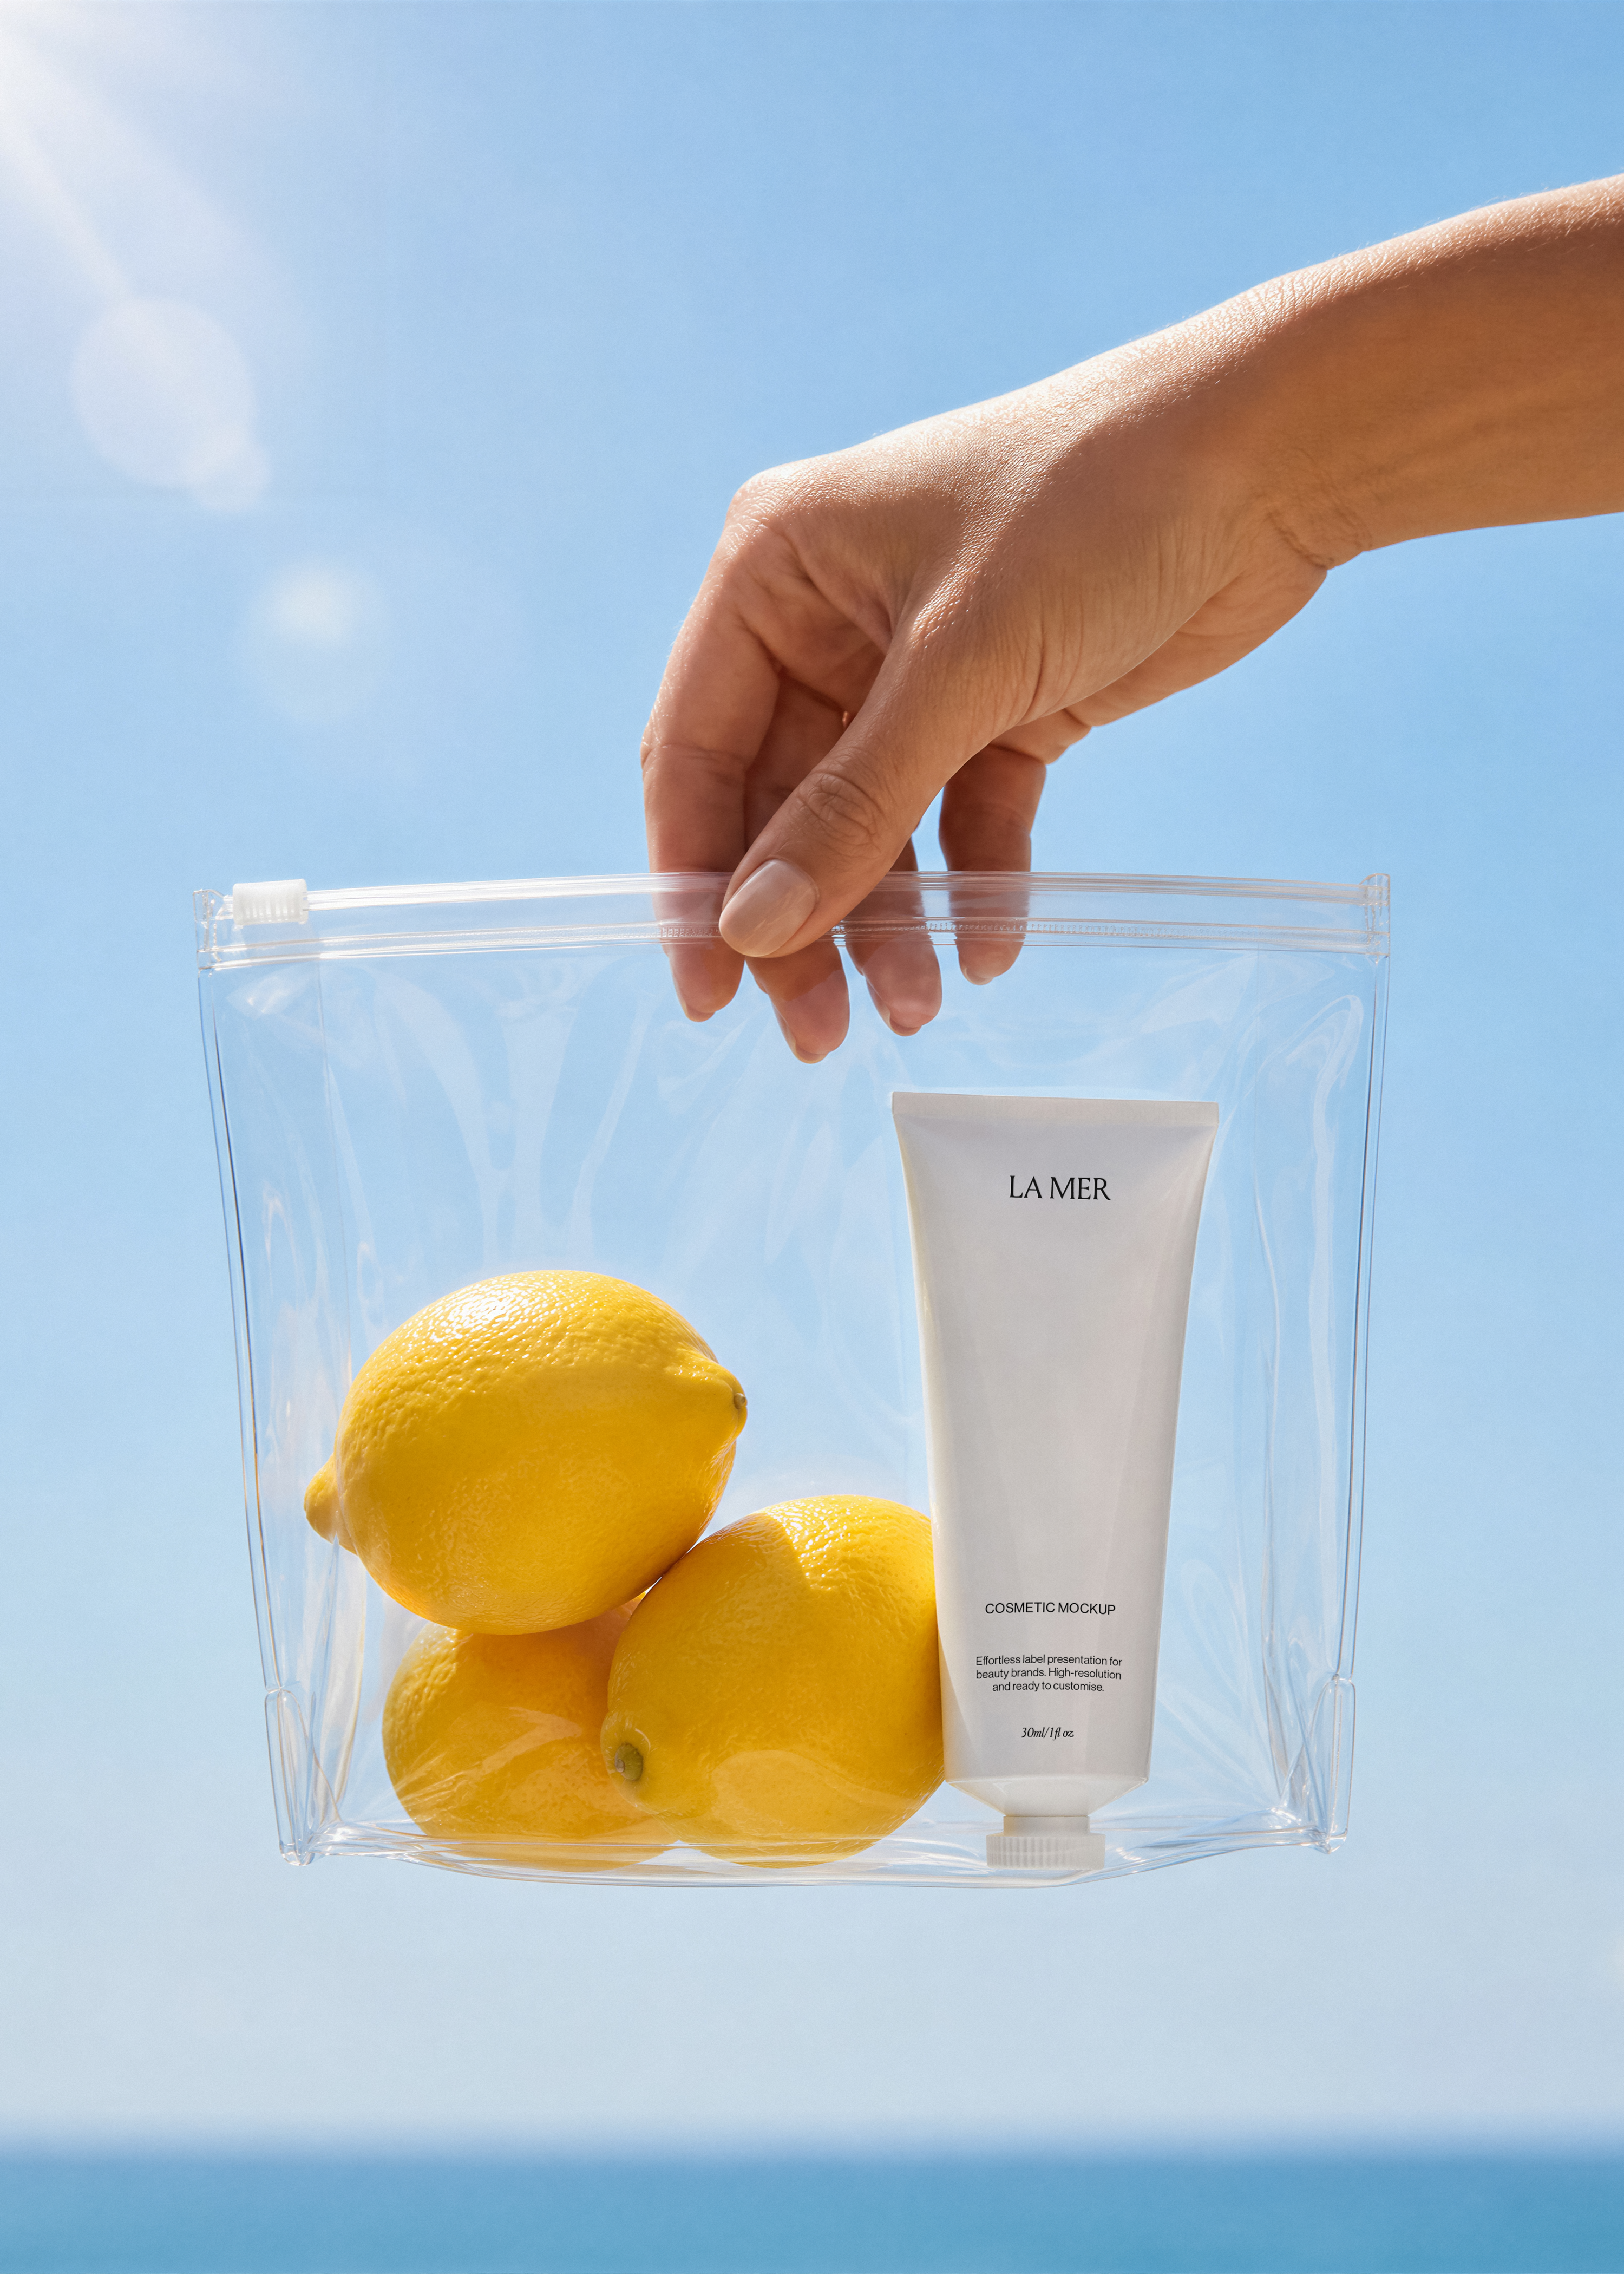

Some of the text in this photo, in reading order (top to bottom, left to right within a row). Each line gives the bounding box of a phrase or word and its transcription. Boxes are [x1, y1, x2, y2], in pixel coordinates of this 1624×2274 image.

[1009, 1175, 1111, 1201] LA MER
[985, 1602, 1116, 1615] COSMETIC MOCKUP
[975, 1654, 1123, 1667] Effortless label presentation for
[976, 1667, 1122, 1680] beauty brands. High-resolution
[992, 1681, 1104, 1692] and ready to customise.
